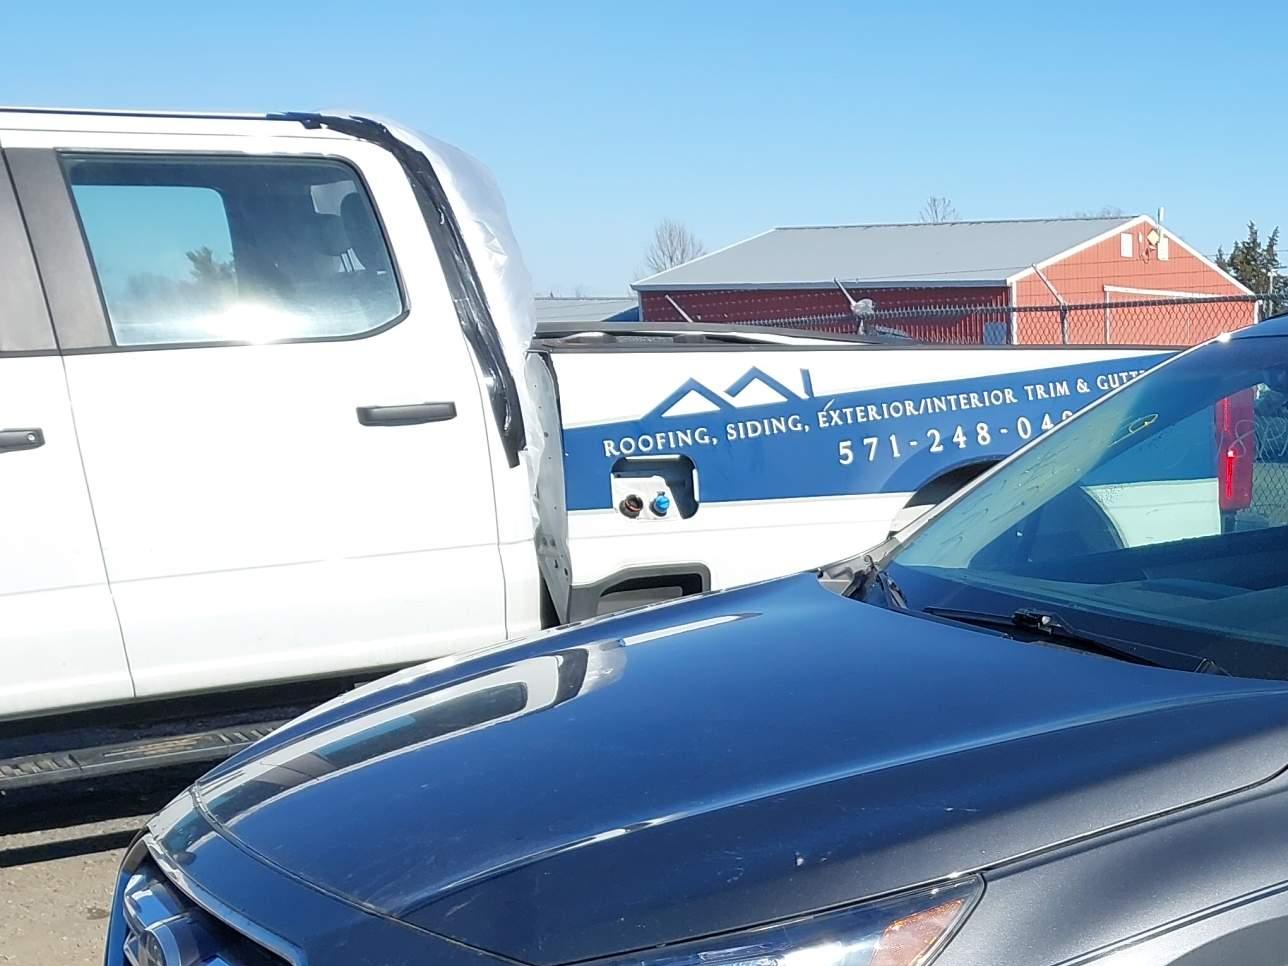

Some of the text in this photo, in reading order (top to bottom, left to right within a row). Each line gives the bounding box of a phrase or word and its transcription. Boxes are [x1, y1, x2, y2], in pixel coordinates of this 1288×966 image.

[603, 427, 718, 457] ROOFING,
[726, 415, 810, 441] SIDING,
[817, 387, 1018, 429] EXTERIOR/INTERIOR
[1024, 380, 1071, 401] TRIM
[1076, 378, 1090, 393] &
